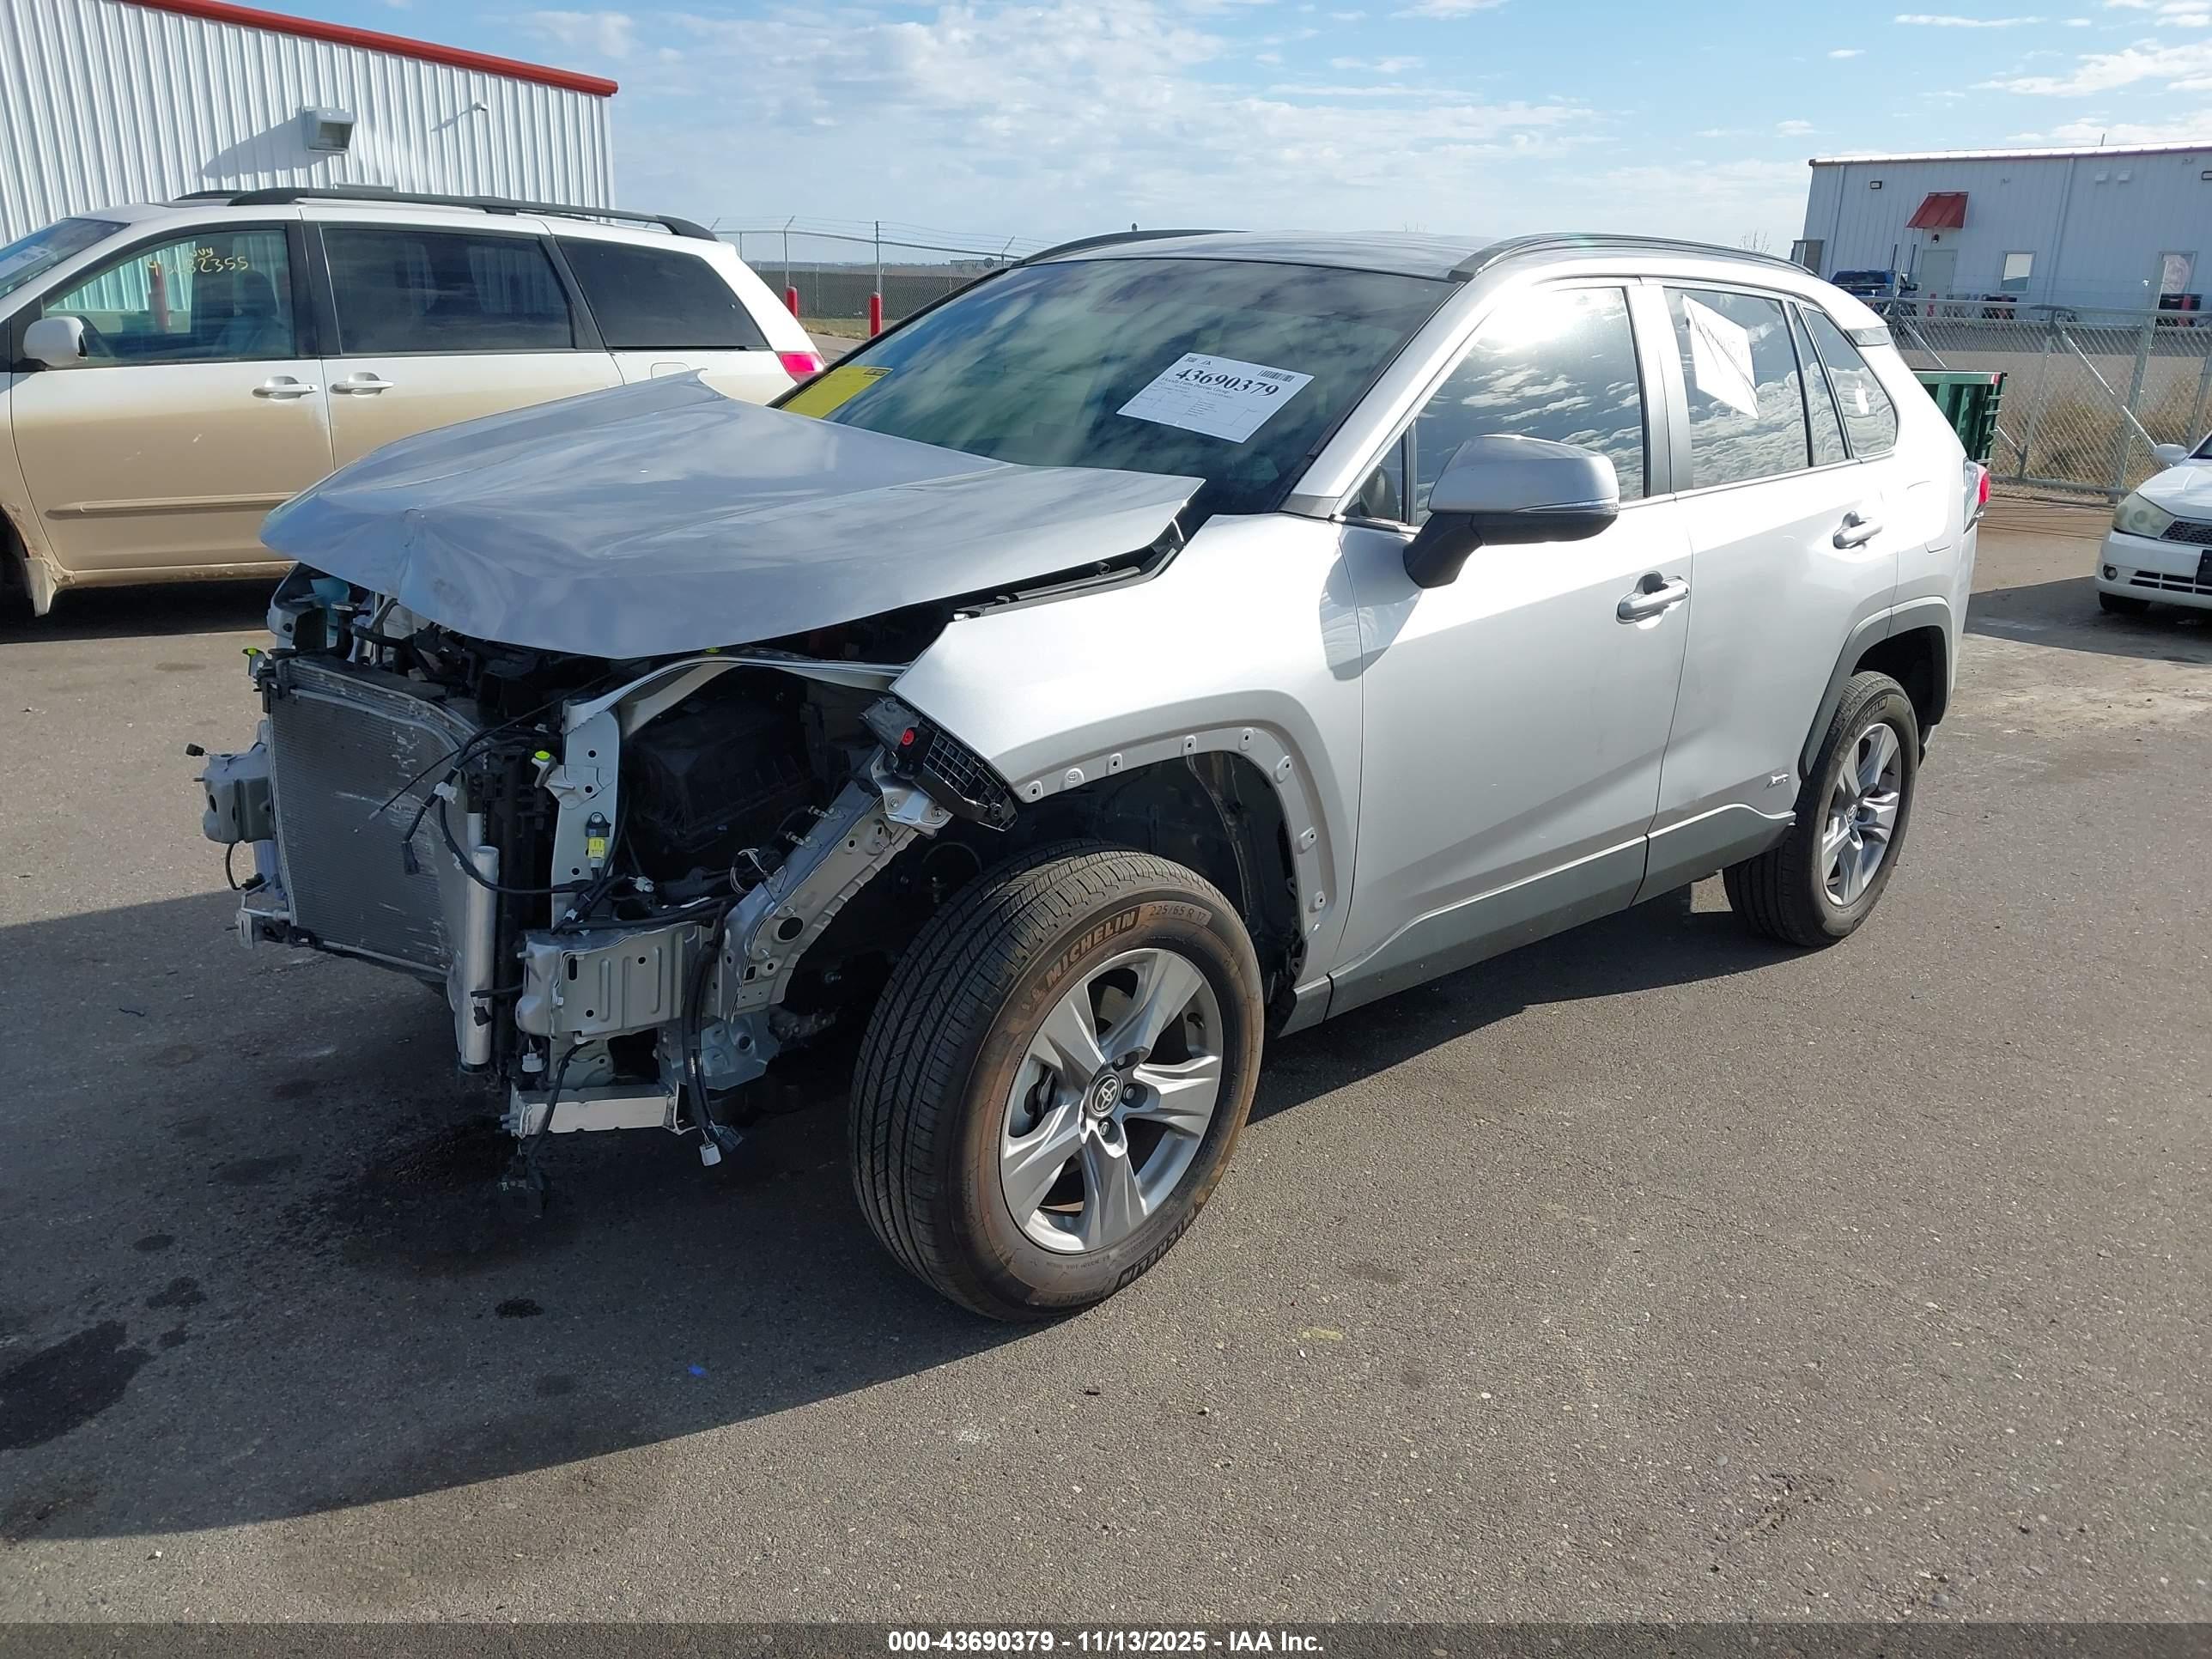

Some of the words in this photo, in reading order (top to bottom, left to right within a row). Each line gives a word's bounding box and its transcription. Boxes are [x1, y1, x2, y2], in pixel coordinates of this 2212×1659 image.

[1176, 368, 1280, 397] 43690379
[1188, 908, 1194, 919] R
[1196, 911, 1206, 921] 17
[1045, 909, 1138, 986] MICHELIN
